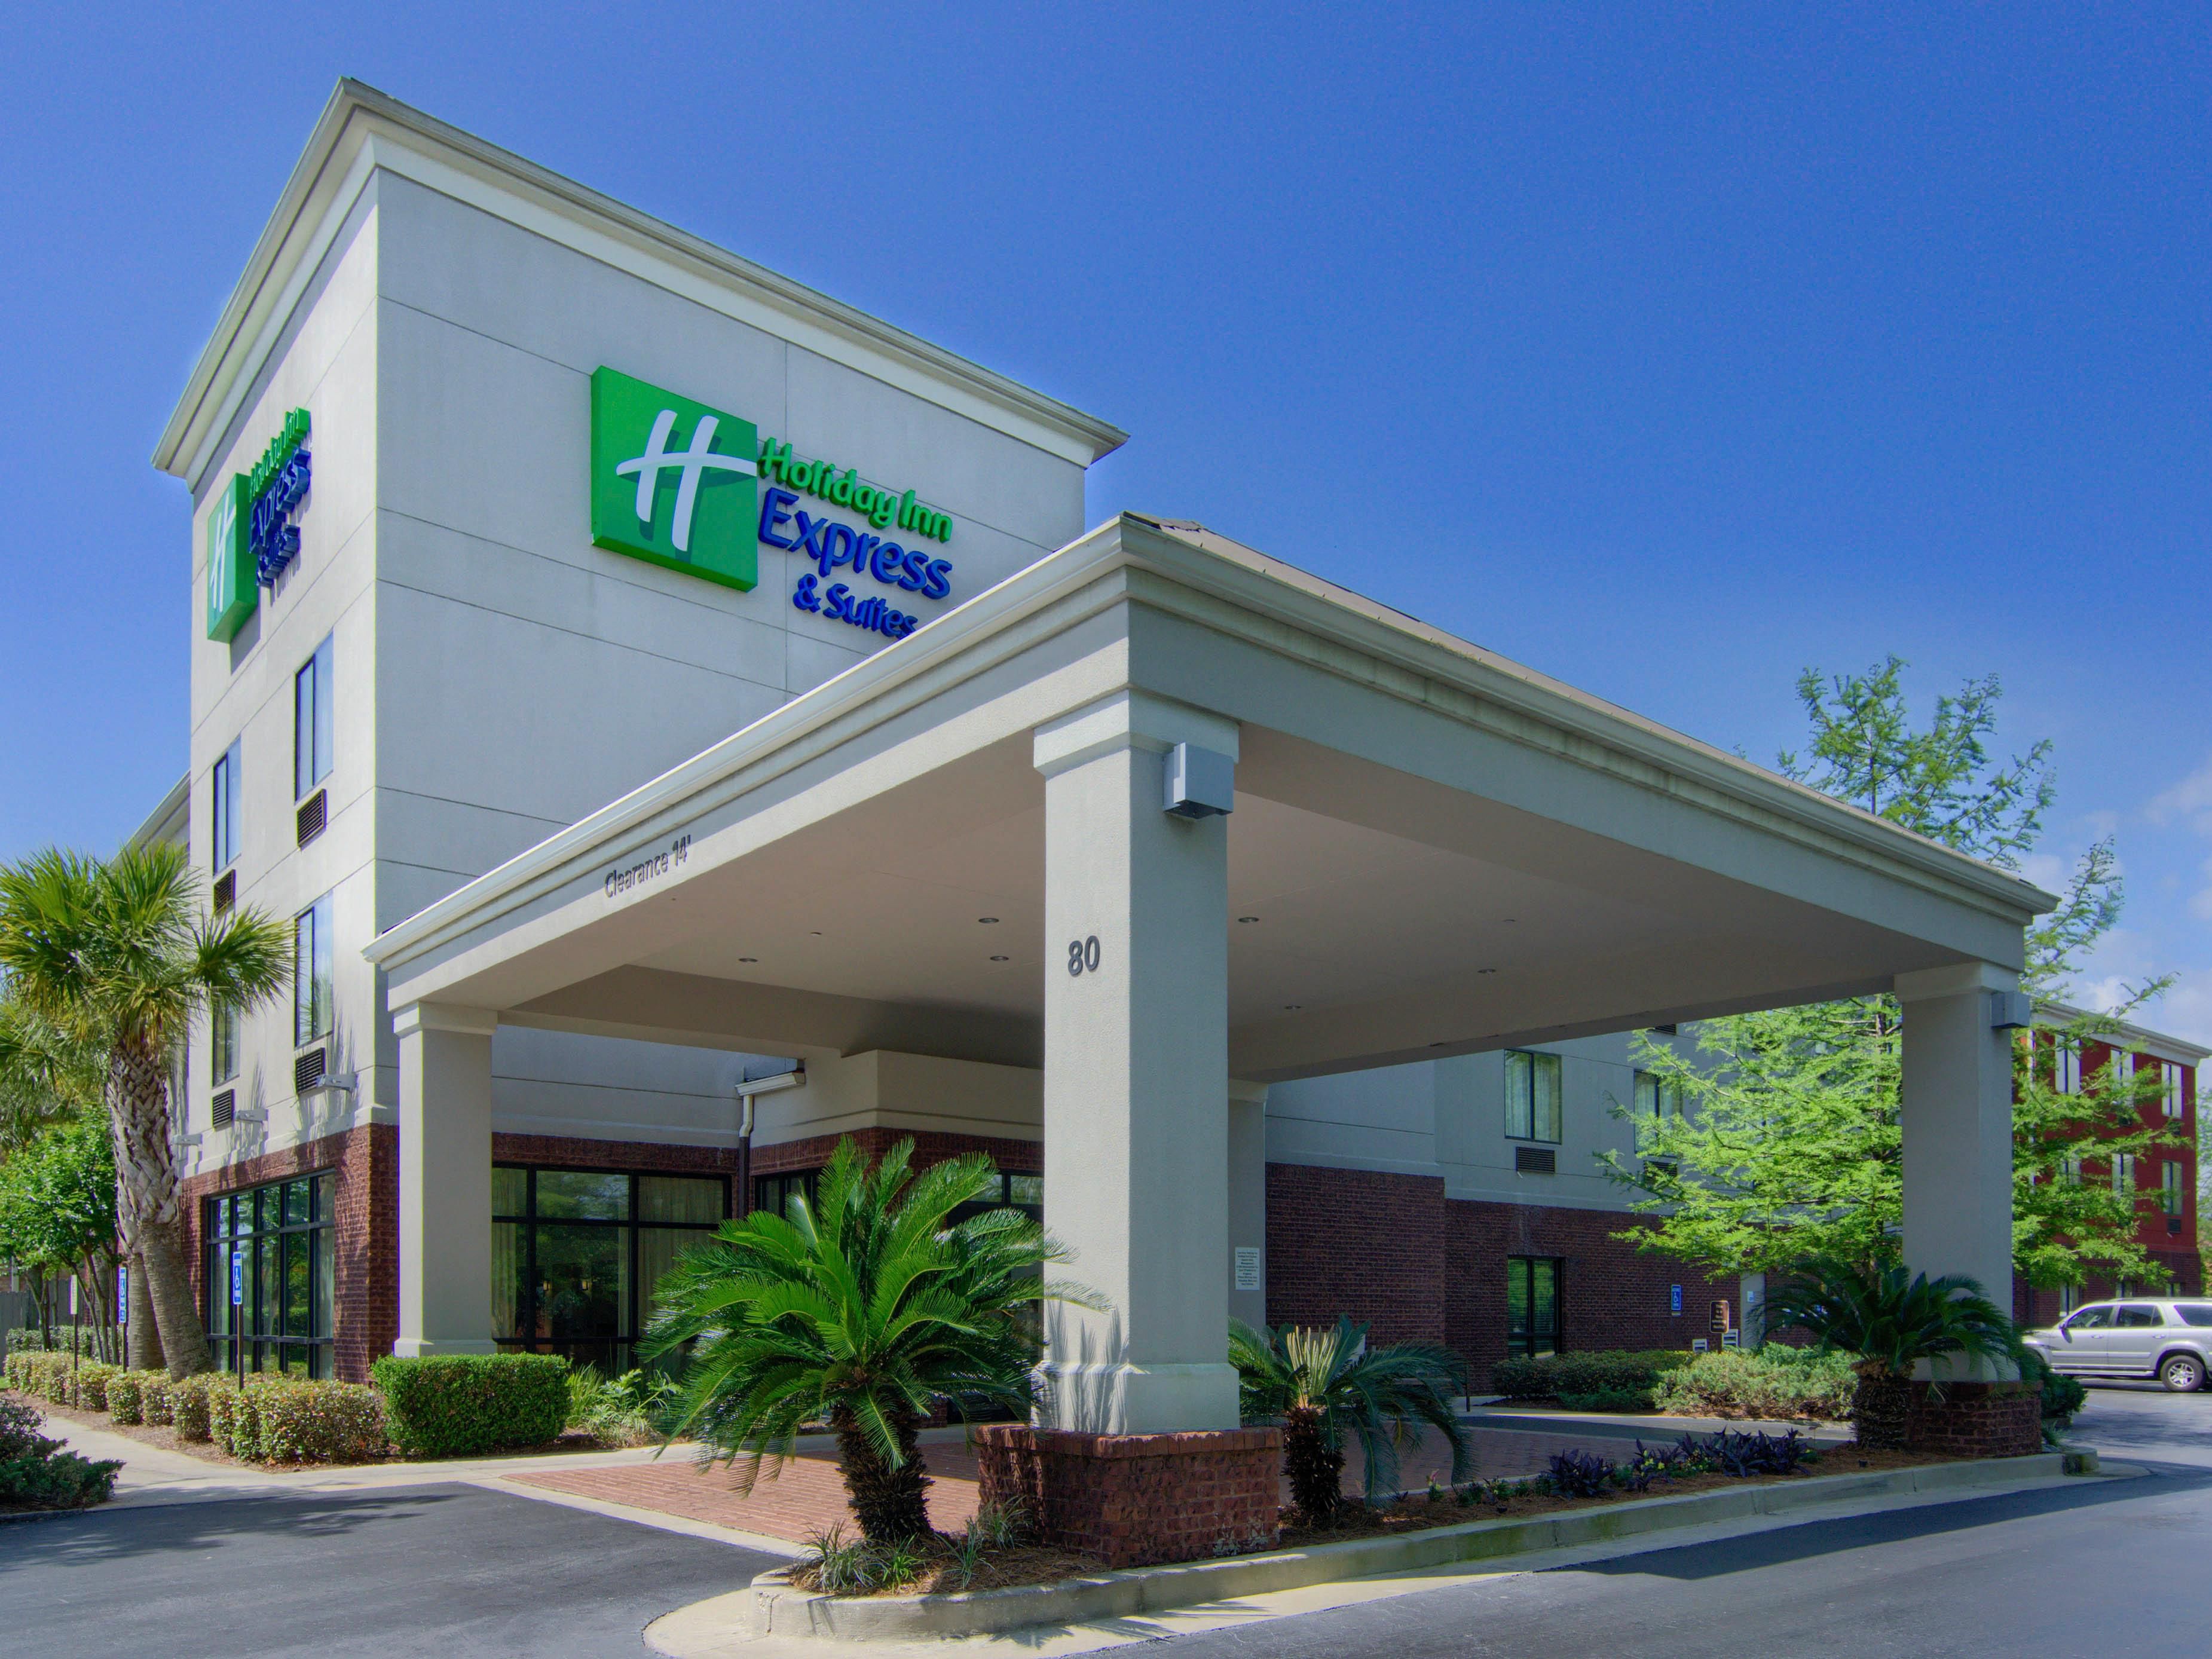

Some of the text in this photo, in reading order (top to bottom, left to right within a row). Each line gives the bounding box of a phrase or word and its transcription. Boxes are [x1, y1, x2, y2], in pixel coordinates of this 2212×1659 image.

[757, 437, 953, 543] Holiday Inn
[758, 487, 953, 599] Express
[793, 573, 822, 613] &
[604, 853, 669, 898] Clearance
[1067, 935, 1100, 977] 80
